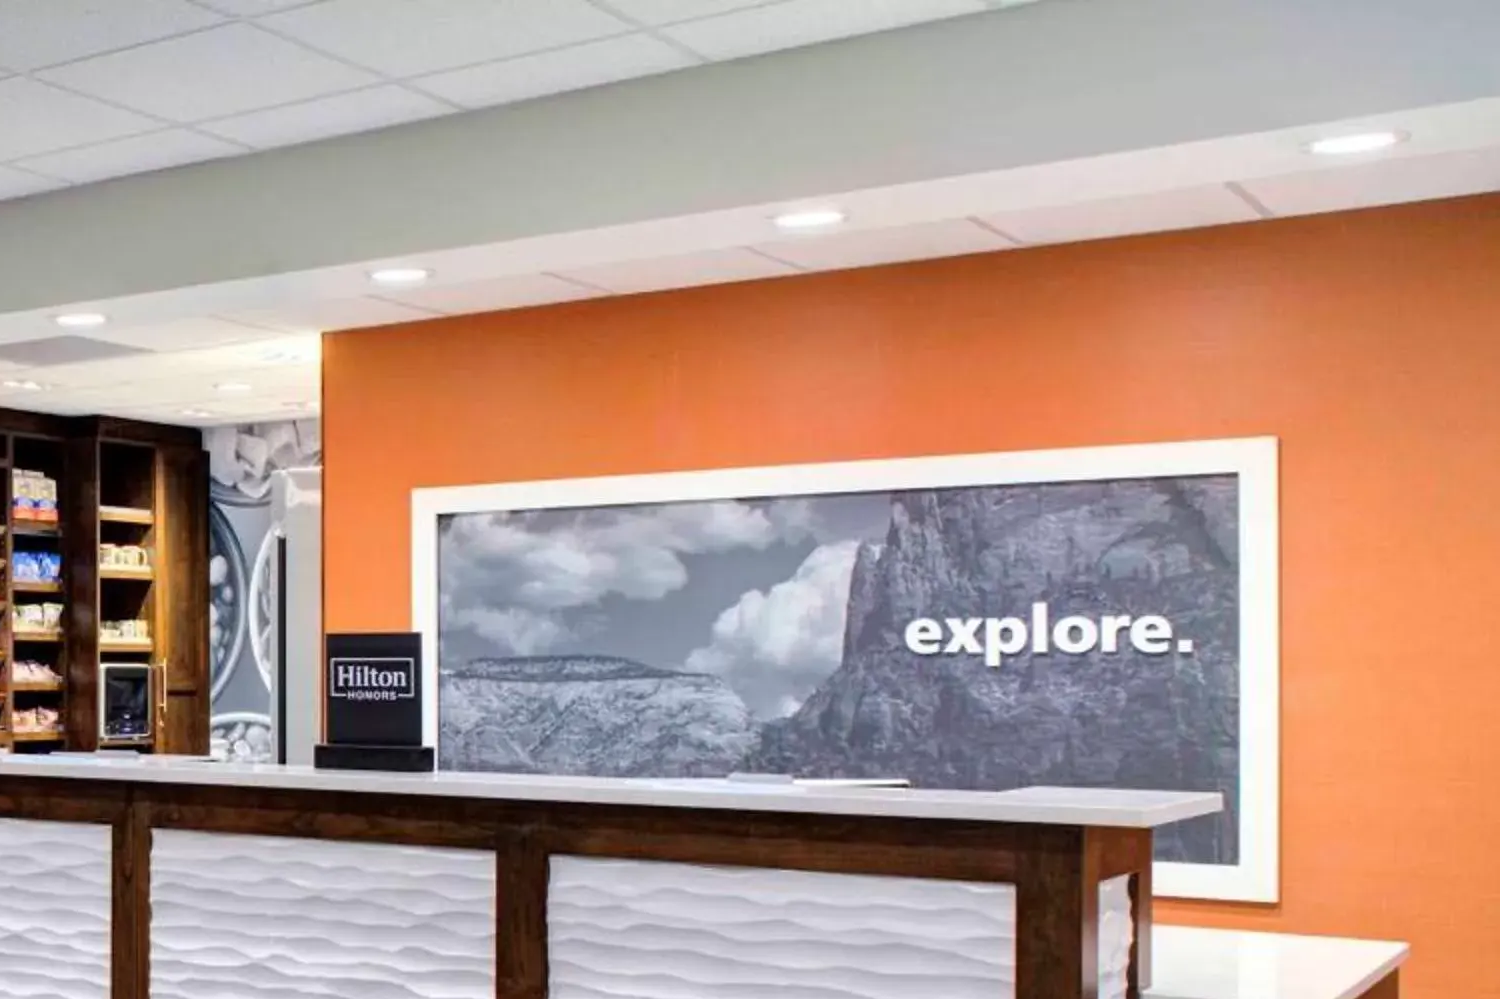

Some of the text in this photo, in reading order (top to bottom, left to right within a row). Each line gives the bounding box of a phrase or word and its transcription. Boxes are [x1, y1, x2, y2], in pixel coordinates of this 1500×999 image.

[904, 601, 1193, 667] explore.
[337, 665, 407, 687] Hilton
[347, 690, 397, 701] HONORS
